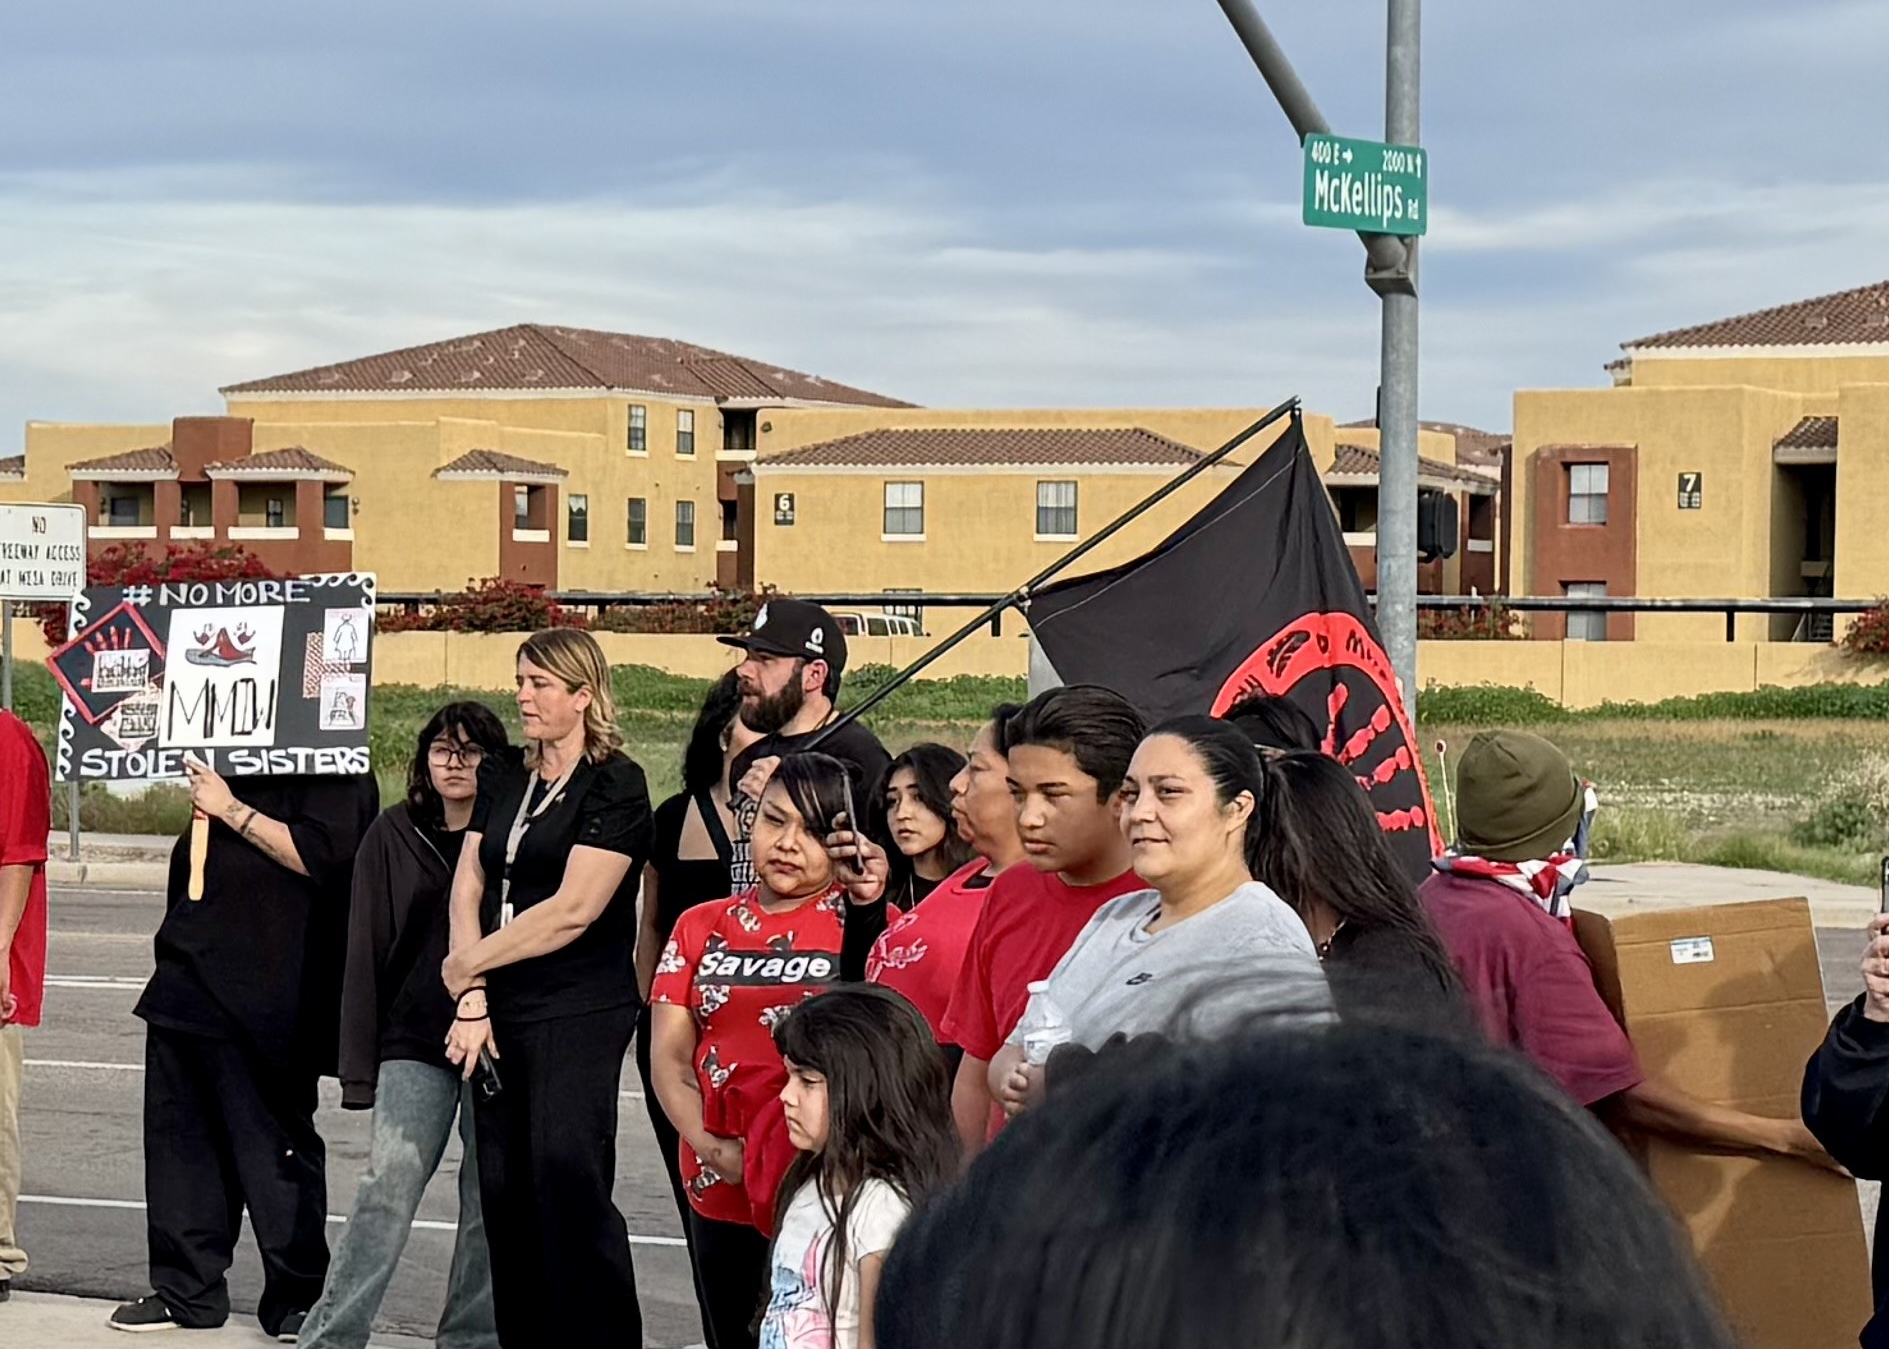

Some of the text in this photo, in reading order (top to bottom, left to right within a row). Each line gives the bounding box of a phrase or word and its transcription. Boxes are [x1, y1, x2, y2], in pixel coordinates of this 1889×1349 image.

[1314, 168, 1403, 229] McKellips
[1683, 474, 1697, 492] 7
[779, 494, 790, 511] 6
[32, 515, 47, 534] NO
[46, 544, 81, 562] ACCESS
[216, 580, 311, 605] MORE
[167, 677, 275, 742] MMIW
[228, 747, 371, 775] SISTERS
[698, 951, 832, 983] Savage
